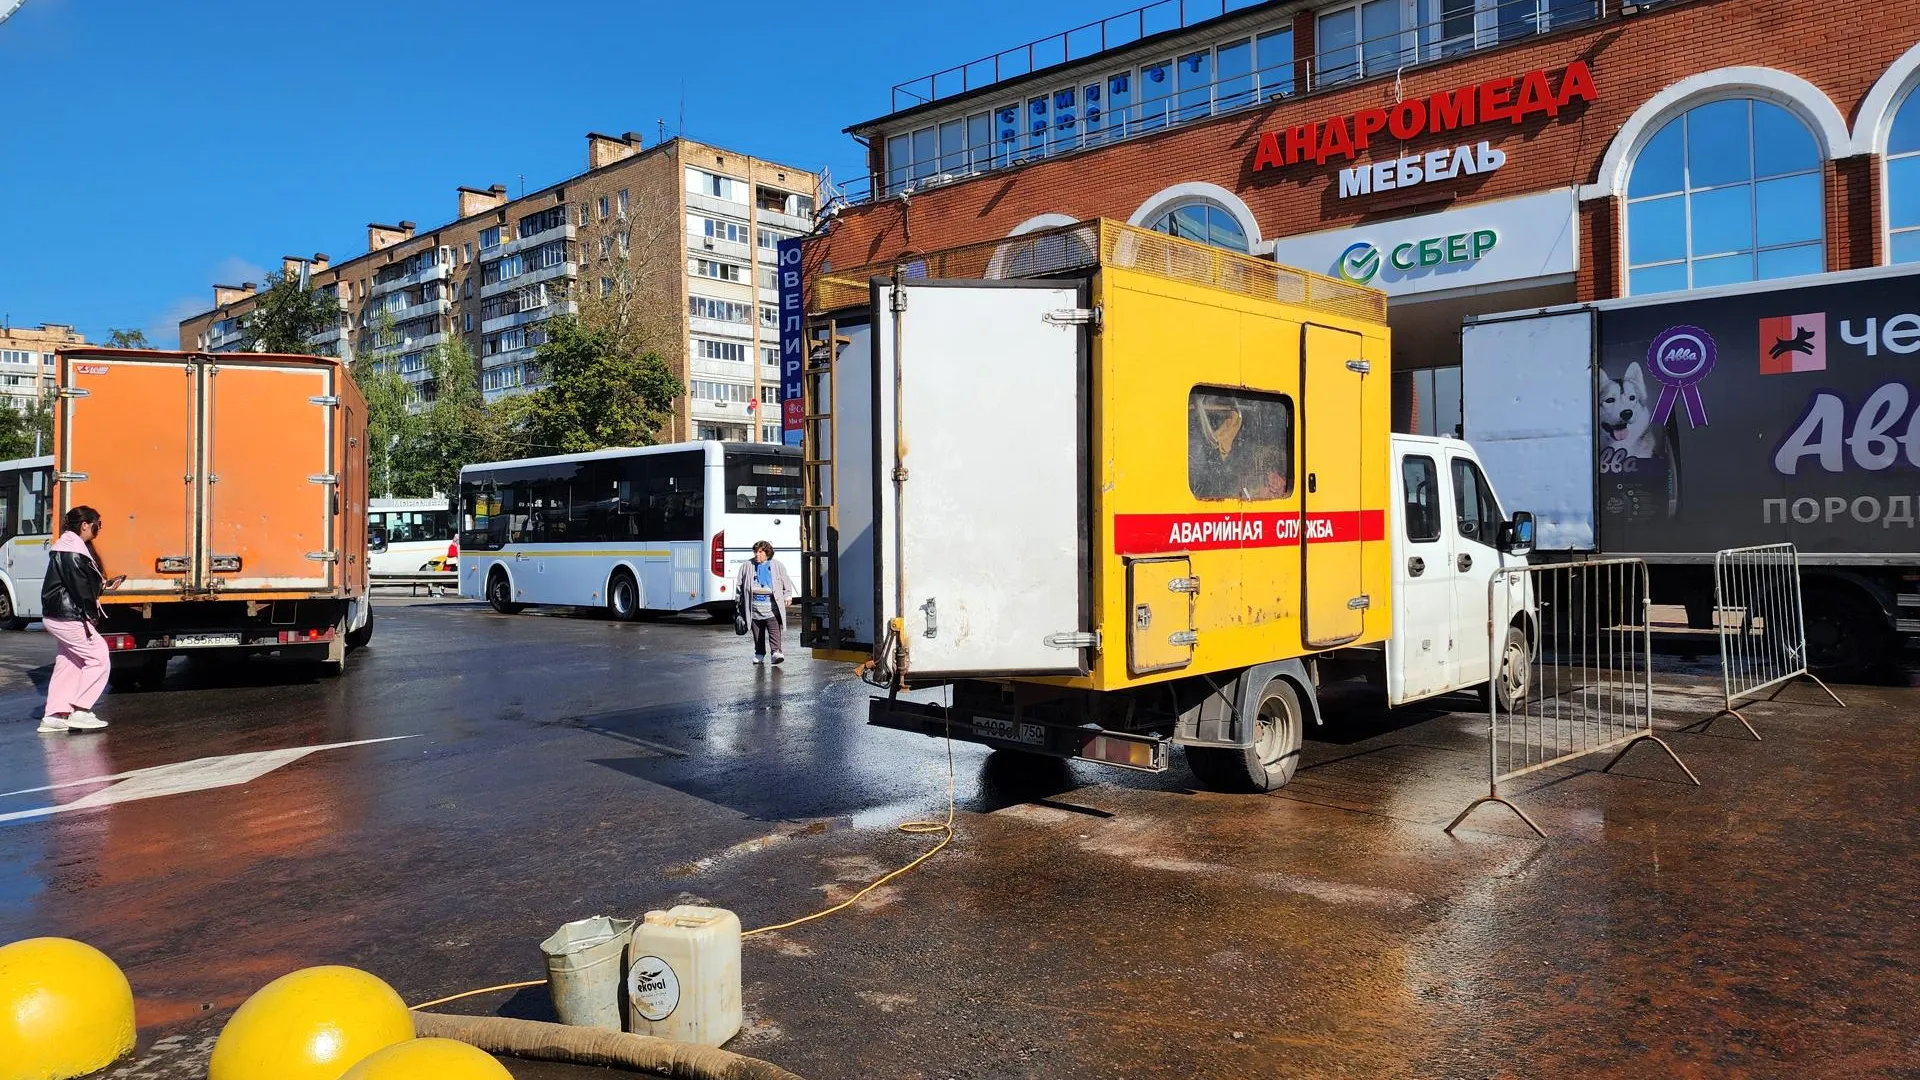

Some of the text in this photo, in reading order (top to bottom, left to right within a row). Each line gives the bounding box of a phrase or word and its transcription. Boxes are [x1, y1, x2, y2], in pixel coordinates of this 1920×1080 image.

[1252, 60, 1599, 172] АНДРОМЕДА
[1338, 140, 1507, 199] МЕБЕЛЬ
[1390, 228, 1499, 271] СБЕР
[1169, 516, 1334, 544] АВАРИЙНАЯ СЛУЖБА
[1762, 494, 1920, 530] ПОРОД
[637, 978, 666, 992] ekoval
